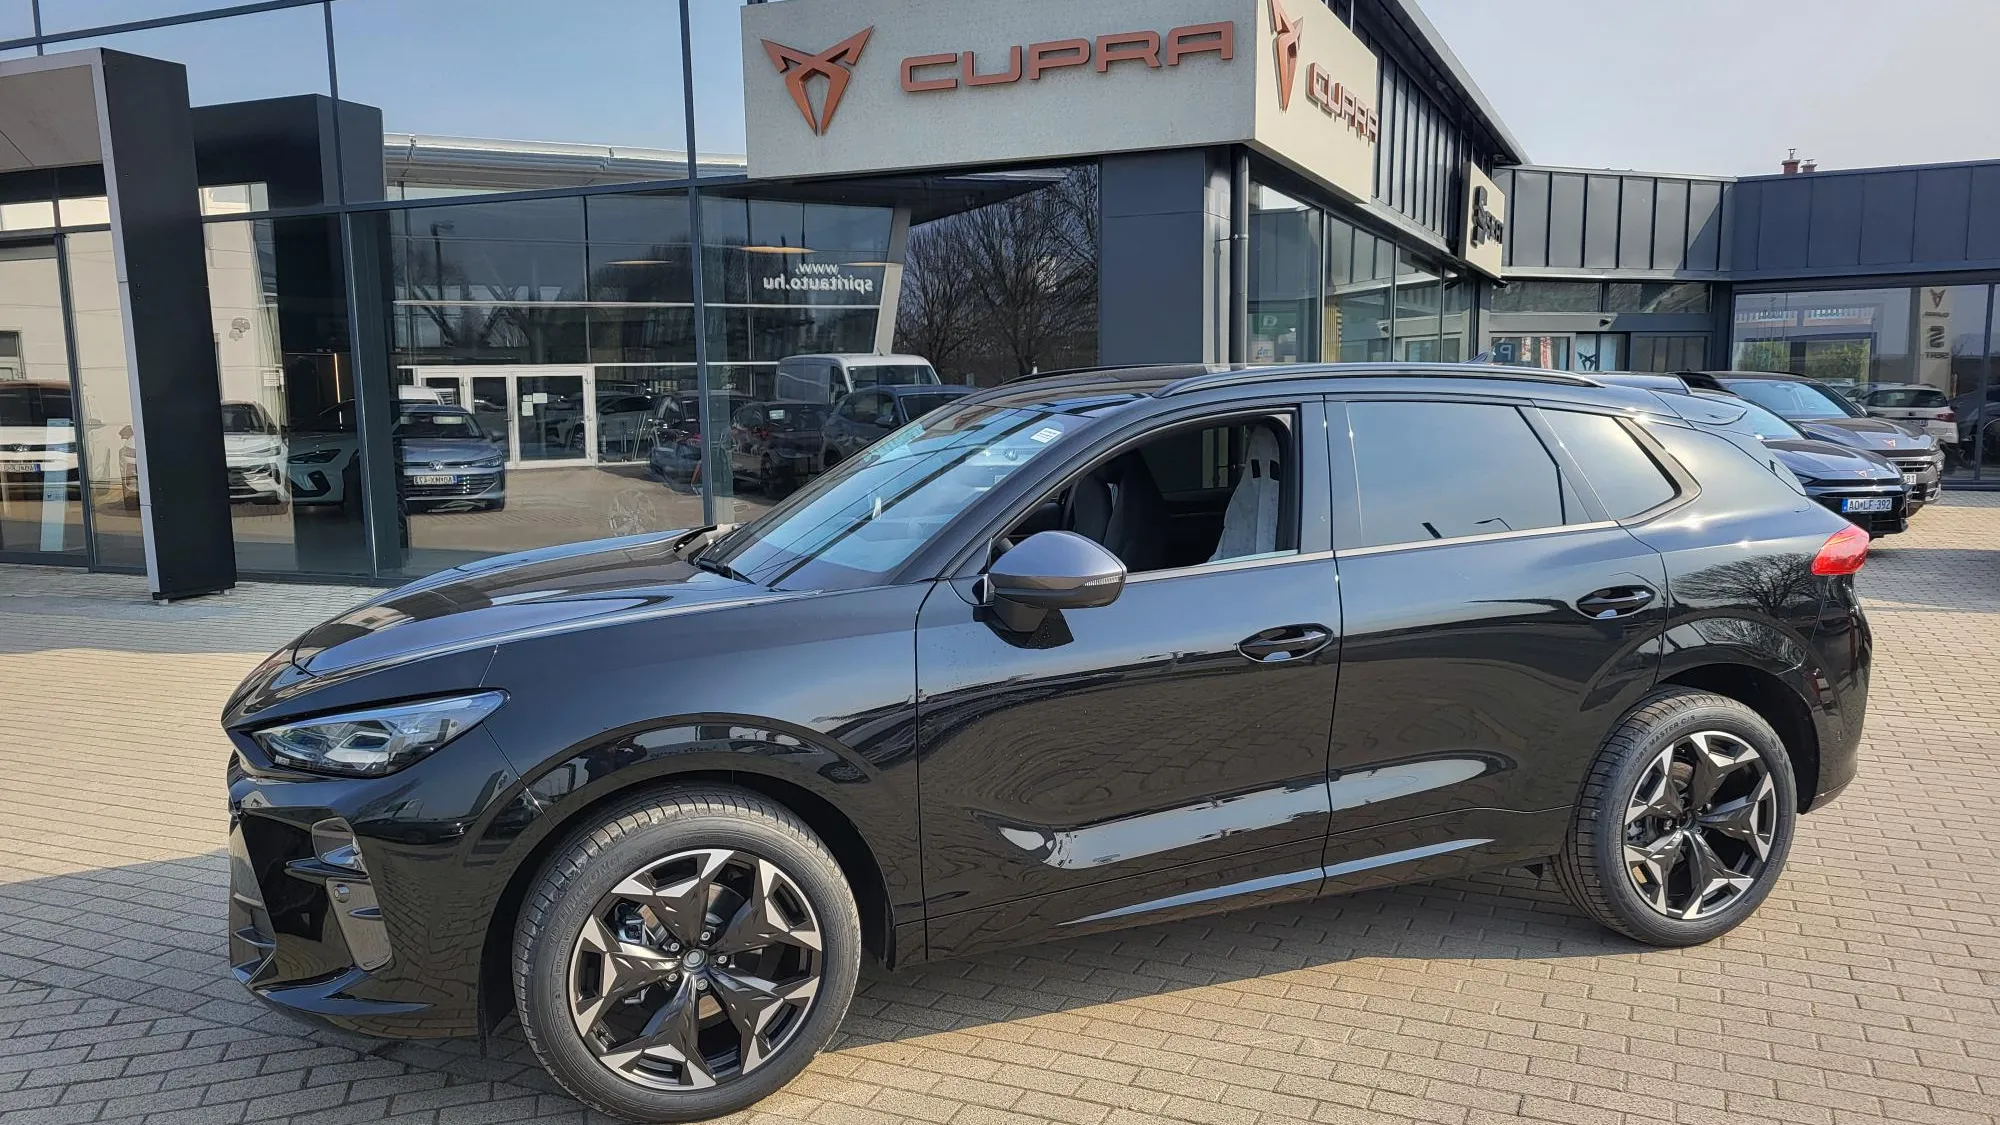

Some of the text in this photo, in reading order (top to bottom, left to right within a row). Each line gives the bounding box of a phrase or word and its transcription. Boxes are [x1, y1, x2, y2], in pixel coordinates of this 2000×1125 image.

[900, 20, 1234, 93] CUPRA
[1307, 62, 1379, 145] CUPRA
[1649, 721, 1680, 747] MASTER
